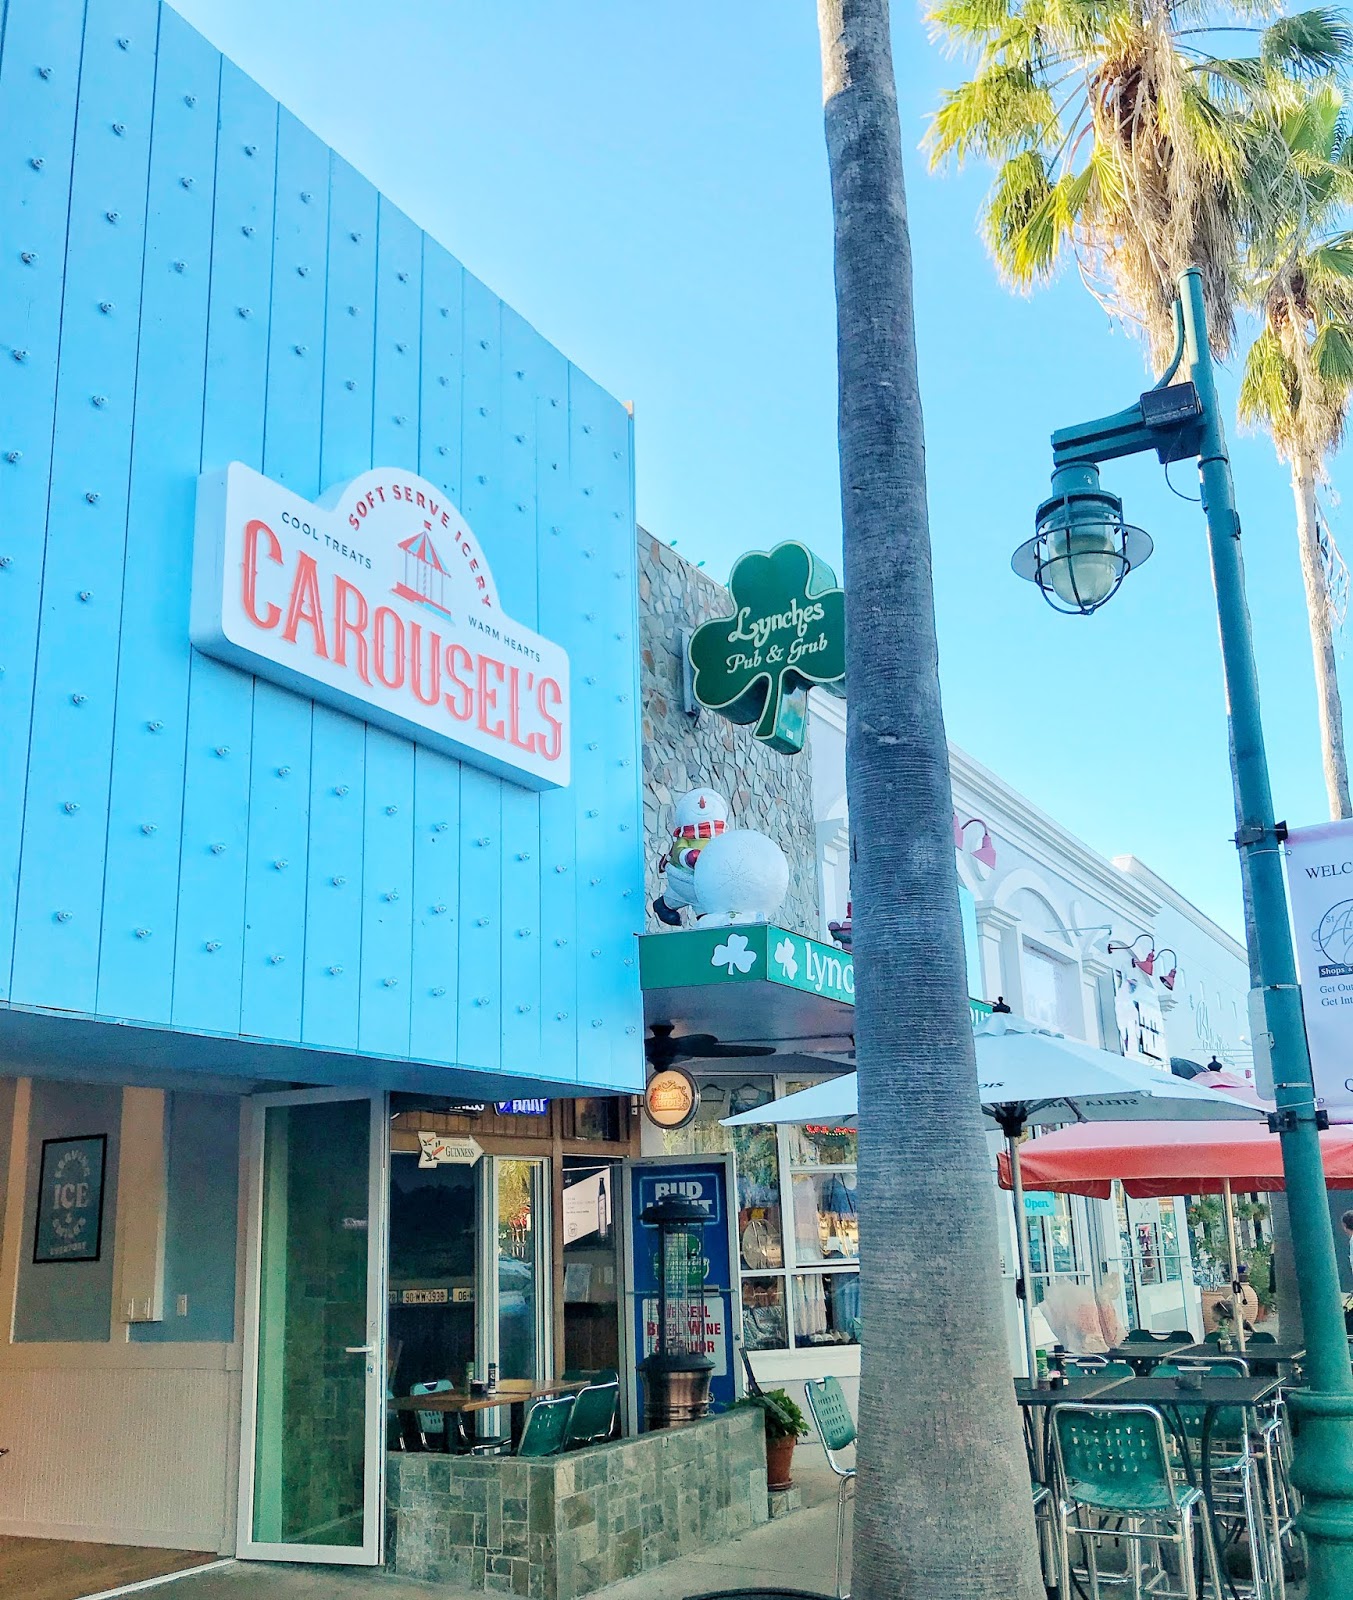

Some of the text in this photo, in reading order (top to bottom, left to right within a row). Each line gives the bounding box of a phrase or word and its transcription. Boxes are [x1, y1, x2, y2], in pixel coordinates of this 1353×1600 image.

[281, 511, 372, 570] COOL TREATS
[348, 484, 491, 608] SOFT SERVE ICERY
[728, 598, 825, 647] Lynches
[241, 519, 563, 761] CAROUSEL'S
[468, 615, 541, 663] WARM HEARTS
[726, 633, 828, 674] Pub & Grub
[1321, 965, 1345, 977] Shops
[1319, 984, 1335, 994] Get
[1321, 998, 1338, 1007] Get
[53, 1182, 89, 1210] ICE
[655, 1182, 703, 1201] BUD
[1024, 1198, 1050, 1211] Open
[688, 1321, 721, 1336] WNE
